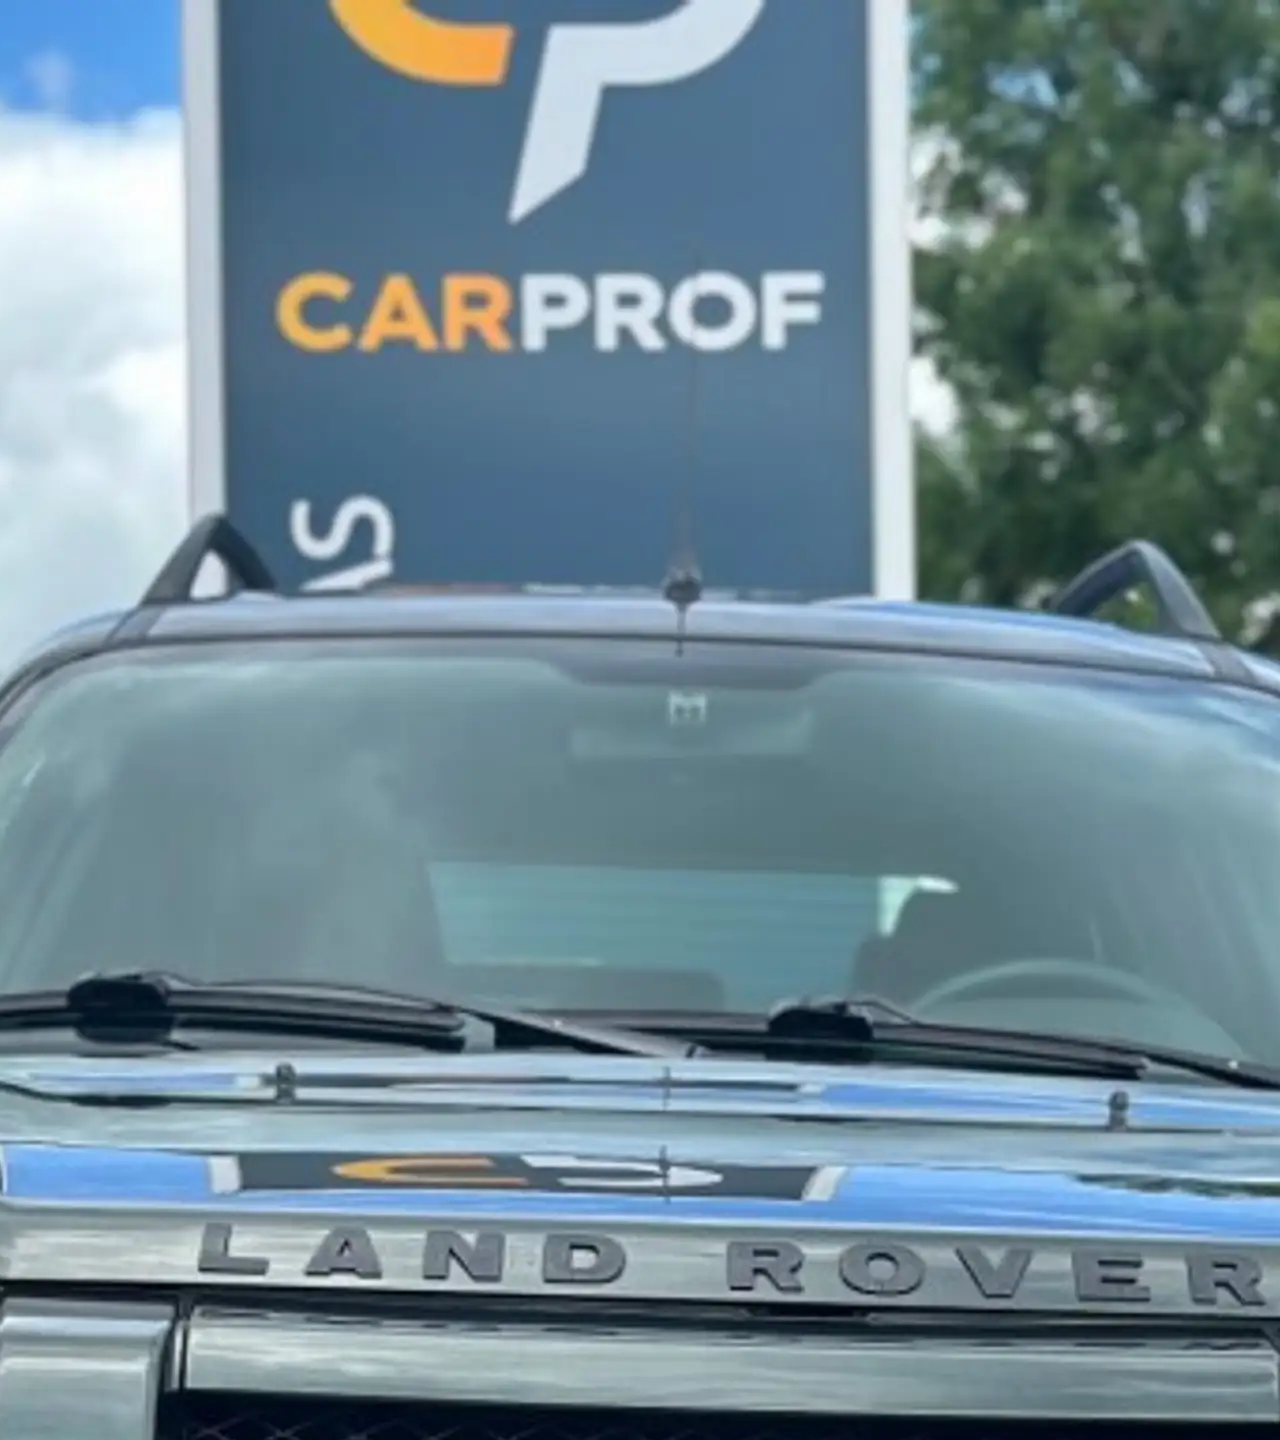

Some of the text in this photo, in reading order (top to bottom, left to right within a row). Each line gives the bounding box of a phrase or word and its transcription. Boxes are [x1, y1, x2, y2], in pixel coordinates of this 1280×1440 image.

[275, 271, 824, 352] CARPROF
[196, 1222, 1268, 1307] LAND ROVER
